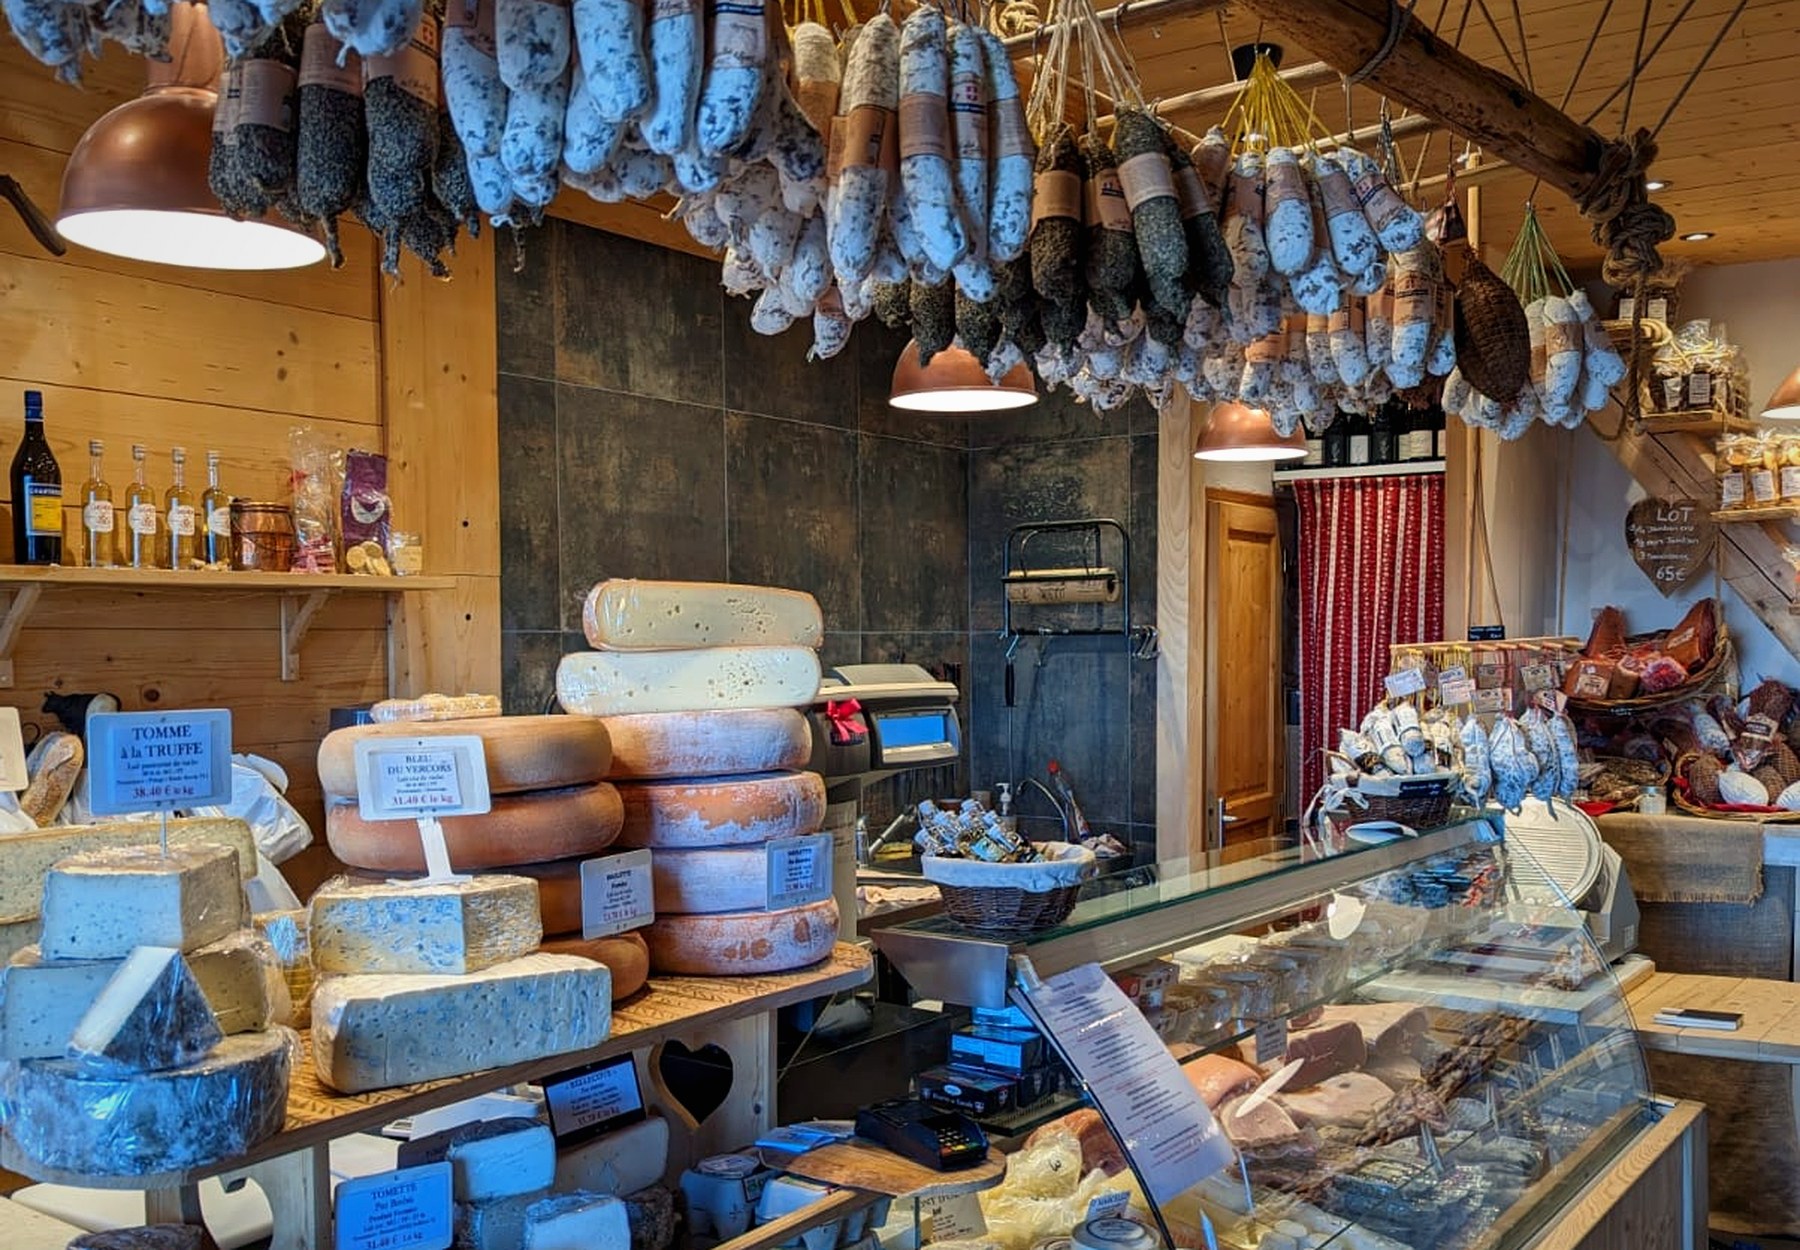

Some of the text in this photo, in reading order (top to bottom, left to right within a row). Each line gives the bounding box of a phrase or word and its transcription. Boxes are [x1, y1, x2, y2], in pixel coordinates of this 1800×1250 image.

[1657, 507, 1694, 522] LOT
[1656, 566, 1687, 581] 65€
[132, 725, 192, 741] TOMME
[145, 742, 203, 757] TRUFFE
[388, 764, 452, 775] DU VERCORS
